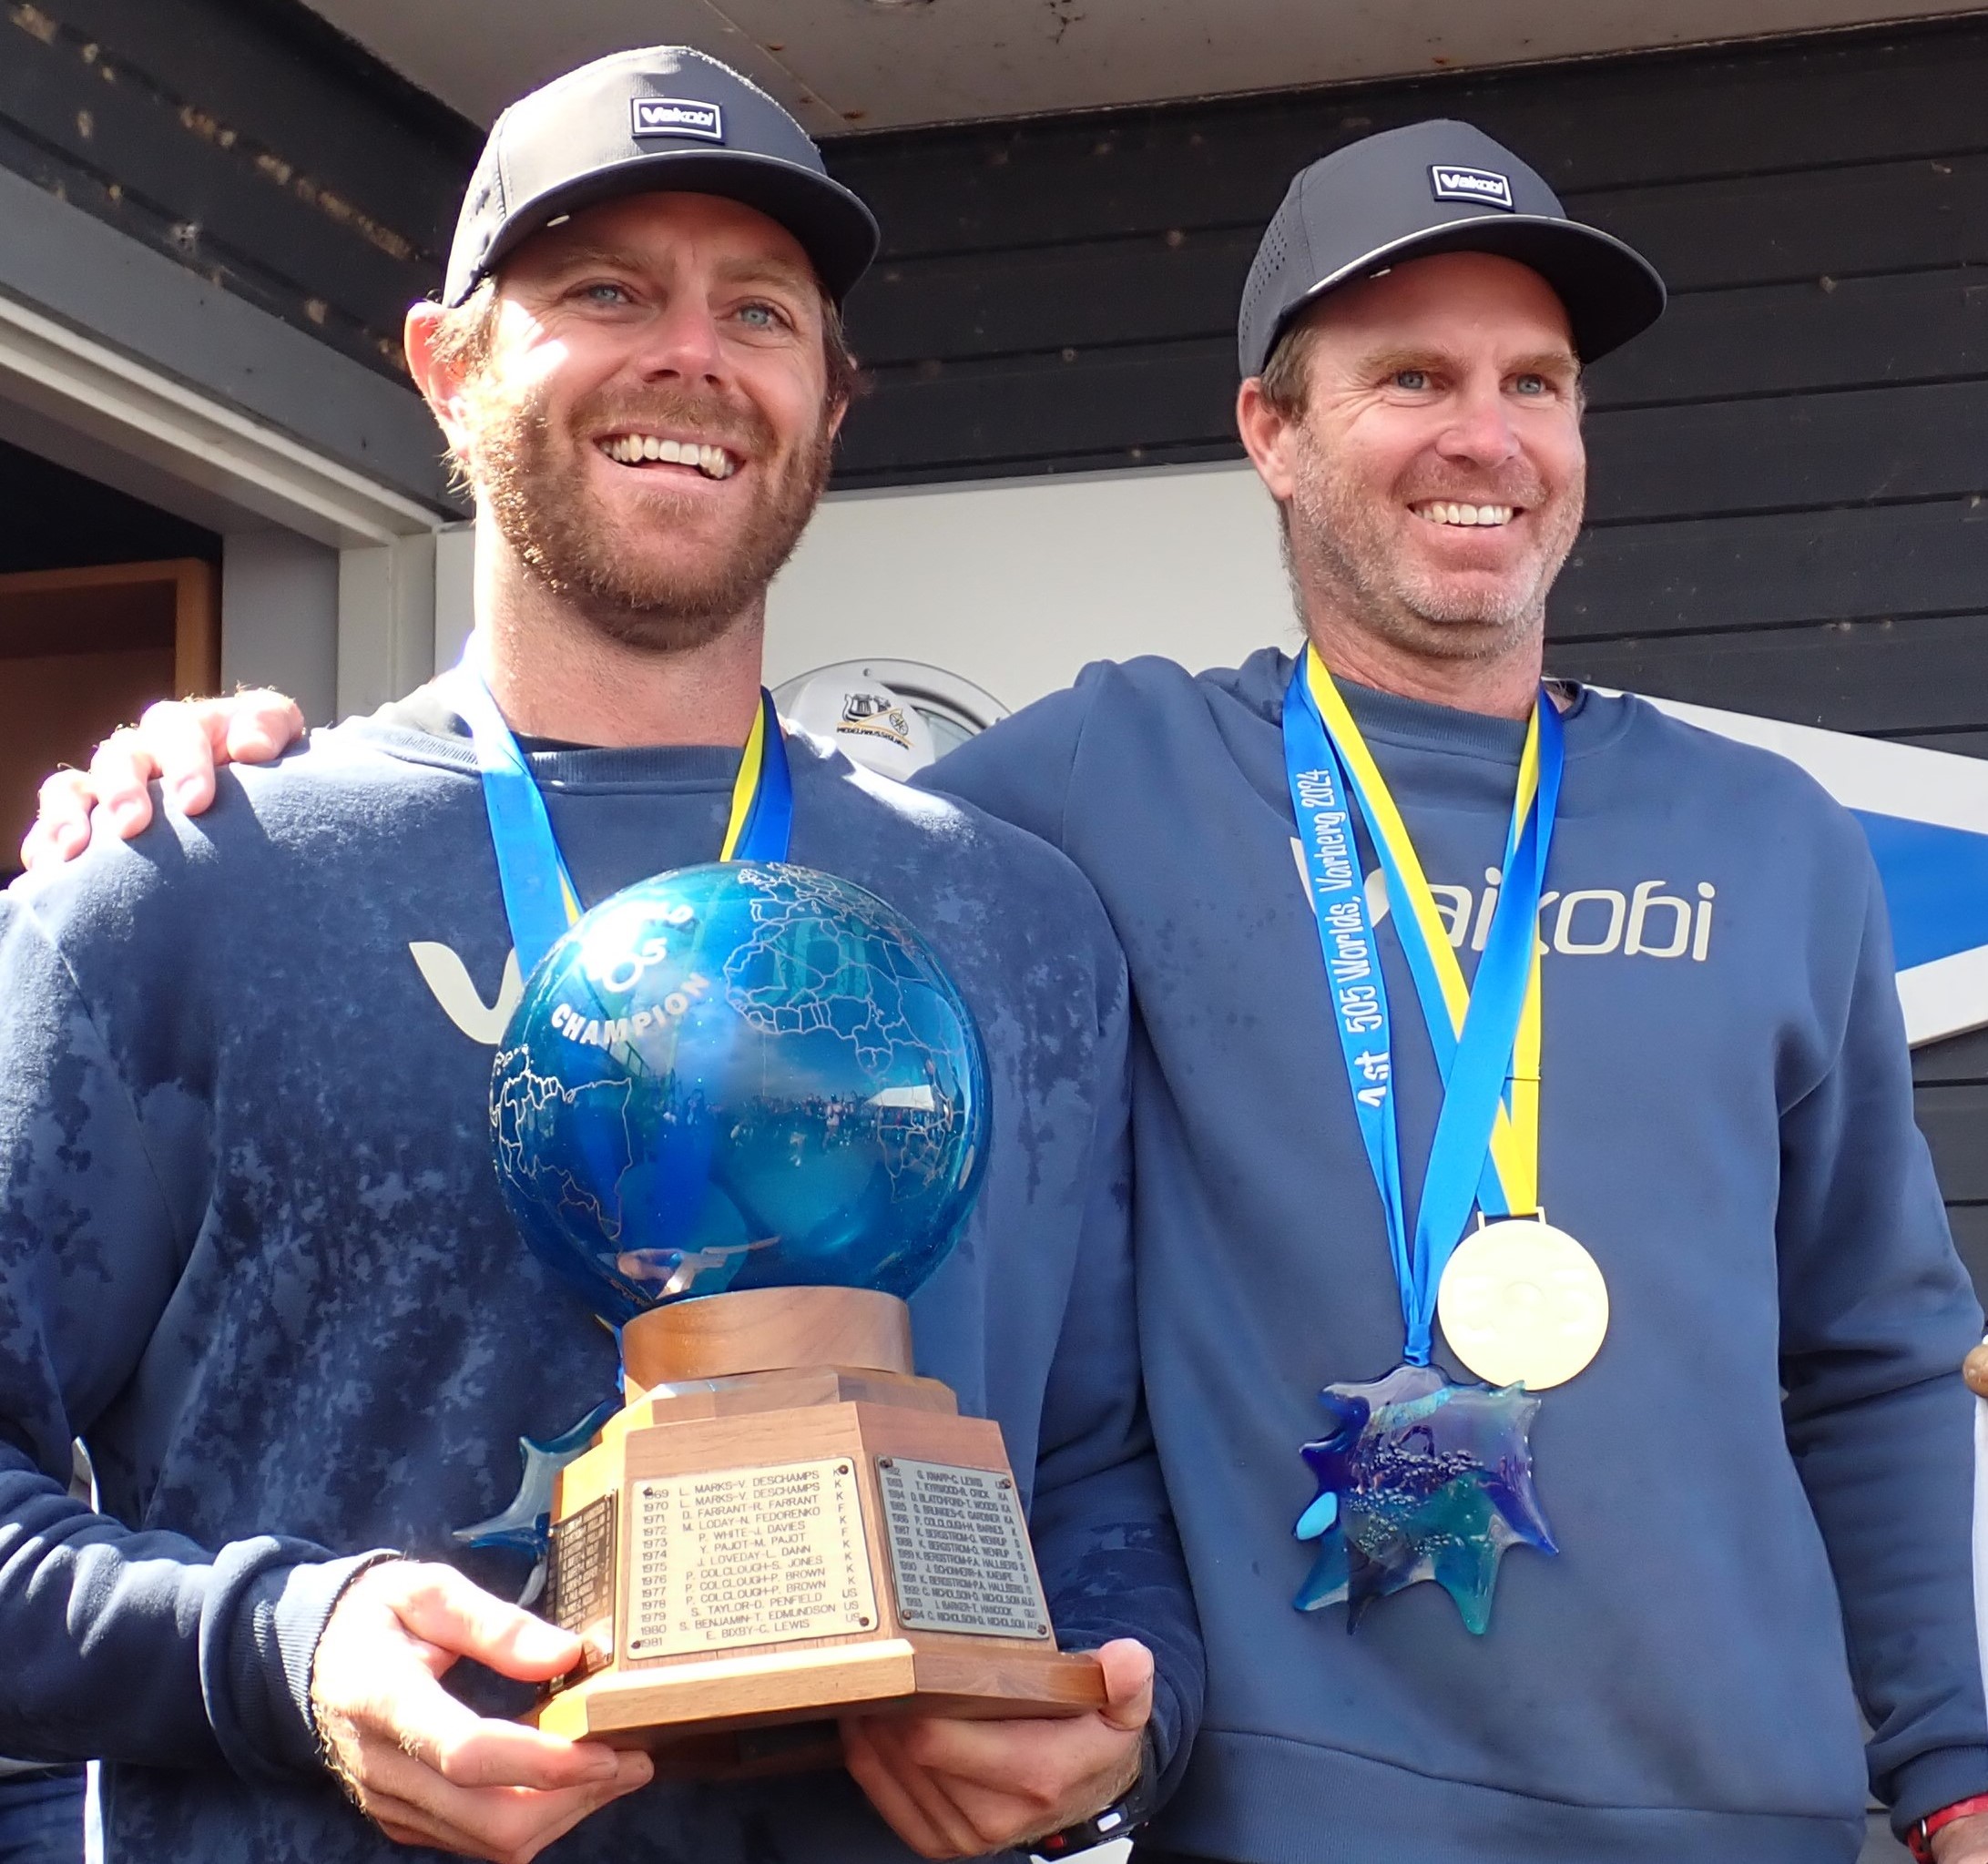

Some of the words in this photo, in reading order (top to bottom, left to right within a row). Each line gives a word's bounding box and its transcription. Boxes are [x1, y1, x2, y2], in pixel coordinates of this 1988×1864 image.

[1297, 768, 1336, 808] 2024
[1313, 810, 1353, 892] Varberg
[1324, 895, 1372, 983] Worlds,
[551, 972, 710, 1044] CHAMPION
[1341, 984, 1382, 1033] 505
[695, 1479, 747, 1493] MARKS-V.
[752, 1470, 819, 1486] DESCHAMPS
[643, 1501, 668, 1512] 1970
[695, 1492, 747, 1505] MARKS-V.
[753, 1482, 821, 1499] DESCHAMPS
[643, 1513, 664, 1523] 1971
[698, 1501, 762, 1517] FARRANT-R.
[769, 1494, 819, 1509] FARRANT
[642, 1537, 667, 1548] 1973
[713, 1525, 760, 1540] WHITE-J.
[767, 1521, 805, 1533] DAVIES
[643, 1525, 667, 1536] 1972
[698, 1515, 749, 1530] LODAY-N.
[755, 1506, 821, 1523] FEDORENKO
[642, 1550, 666, 1561] 1974
[714, 1537, 766, 1553] PAJOT-M.
[770, 1533, 806, 1545] PAJOT
[642, 1562, 667, 1574] 1975
[710, 1548, 776, 1564] LOVEDAY-L.
[781, 1544, 810, 1556] DANN
[641, 1586, 666, 1598] 1977
[699, 1573, 780, 1591] COLCLOUGH-P.
[785, 1567, 825, 1580] BROWN
[642, 1574, 667, 1585] 1976
[700, 1560, 781, 1578] COLCLOUGH-S.
[787, 1555, 822, 1568] JONES
[641, 1599, 666, 1610] 1978
[700, 1584, 780, 1603] COLCLOUGH-P.
[786, 1579, 826, 1593] BROWN
[641, 1611, 666, 1623] 1979
[708, 1599, 764, 1614] TAYLOR-D.
[770, 1592, 822, 1606] PENFIELD
[640, 1624, 666, 1635] 1980
[695, 1612, 762, 1629] BENJAMIN-T.
[769, 1603, 836, 1620] EDMUNDSON
[721, 1623, 769, 1638] BIXBY-C.
[774, 1618, 810, 1631] LEWIS
